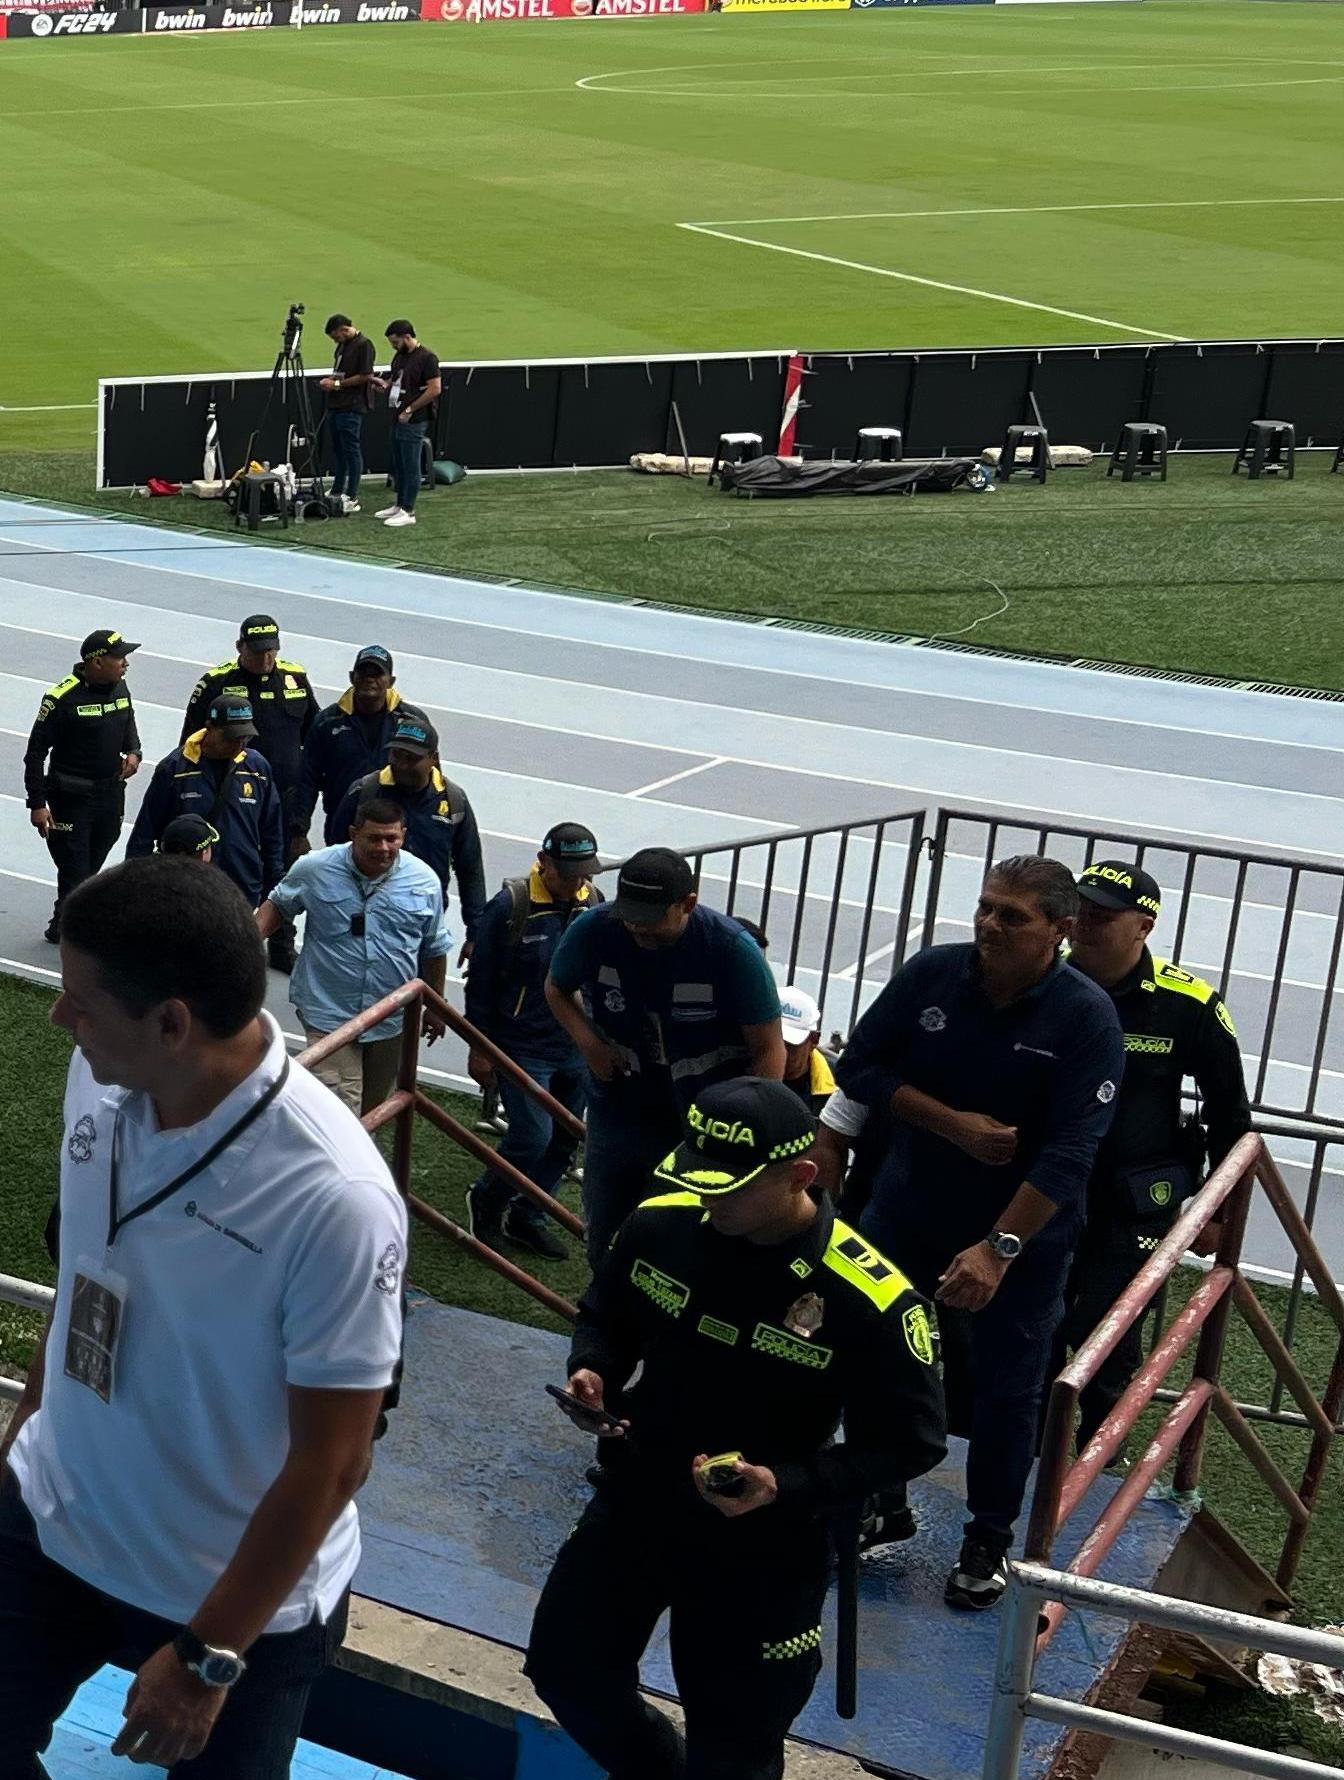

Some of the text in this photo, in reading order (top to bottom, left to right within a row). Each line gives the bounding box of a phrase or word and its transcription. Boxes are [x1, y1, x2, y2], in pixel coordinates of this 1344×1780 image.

[221, 6, 272, 27] bwin
[289, 3, 341, 24] bwin
[357, 1, 409, 22] bwin
[465, 0, 554, 21] AMSTEL
[595, 0, 685, 15] AMSTEL
[155, 8, 206, 30] bwin
